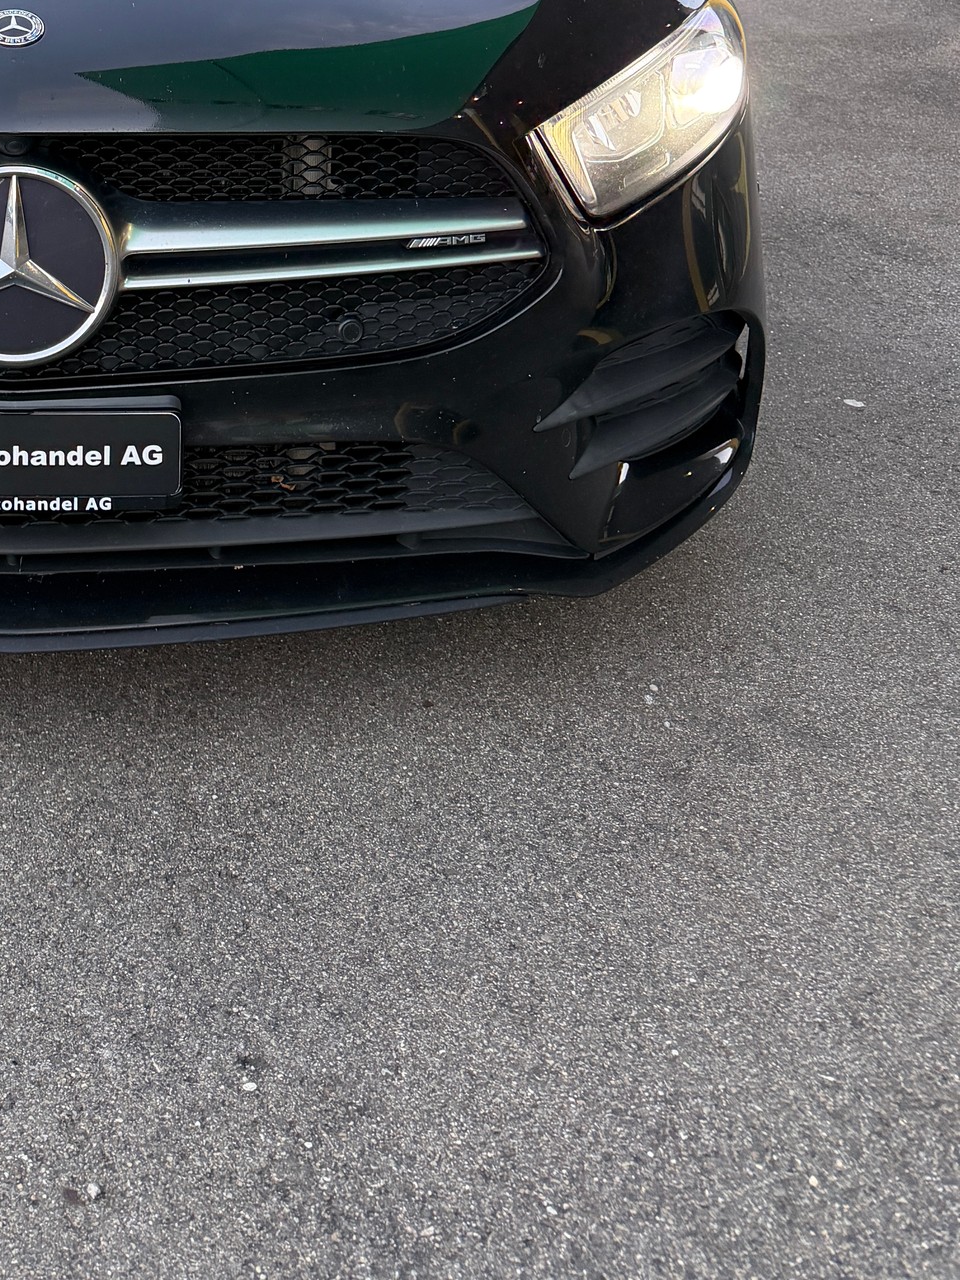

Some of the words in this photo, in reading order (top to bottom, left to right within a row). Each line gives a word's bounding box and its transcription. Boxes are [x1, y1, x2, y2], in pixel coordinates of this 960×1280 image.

[436, 233, 486, 246] AMG
[120, 444, 164, 466] AG
[85, 496, 112, 511] AG
